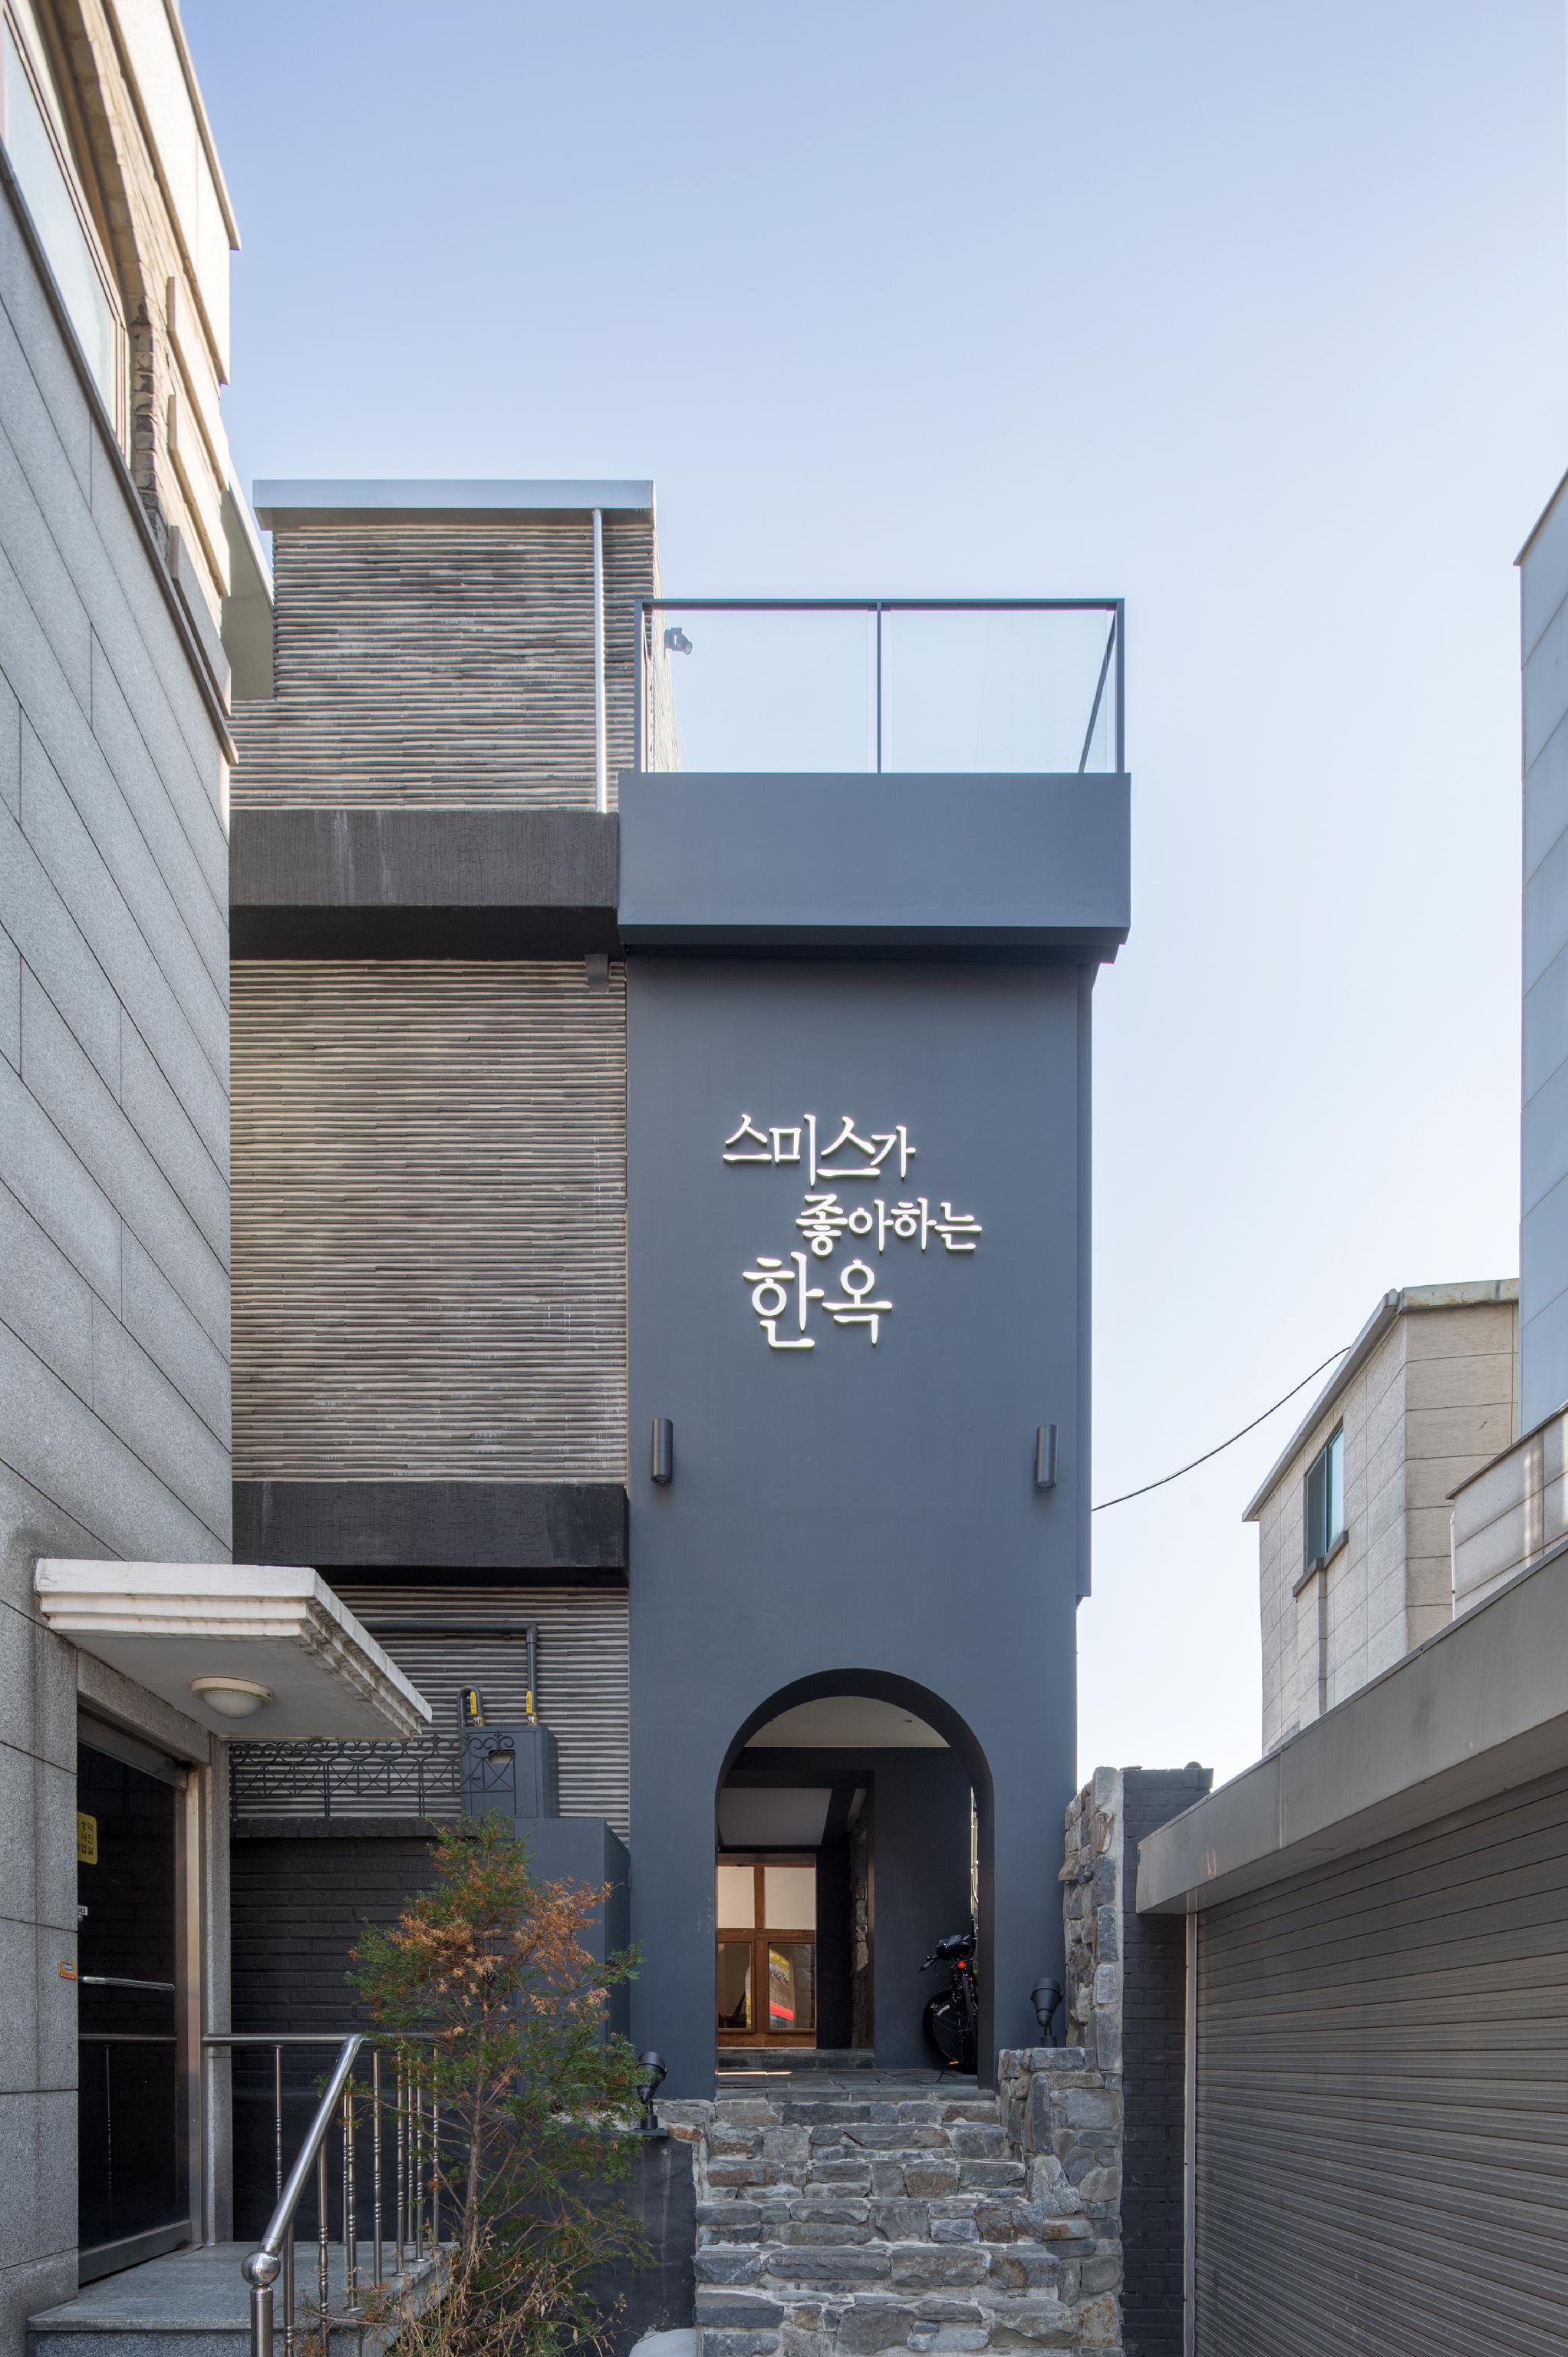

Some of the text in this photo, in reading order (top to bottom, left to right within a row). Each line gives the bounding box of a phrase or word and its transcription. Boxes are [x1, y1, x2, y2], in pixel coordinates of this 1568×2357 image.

[723, 1113, 917, 1188] 스미스가
[795, 1193, 983, 1256] 좋아하는
[742, 1251, 893, 1348] 한옥
